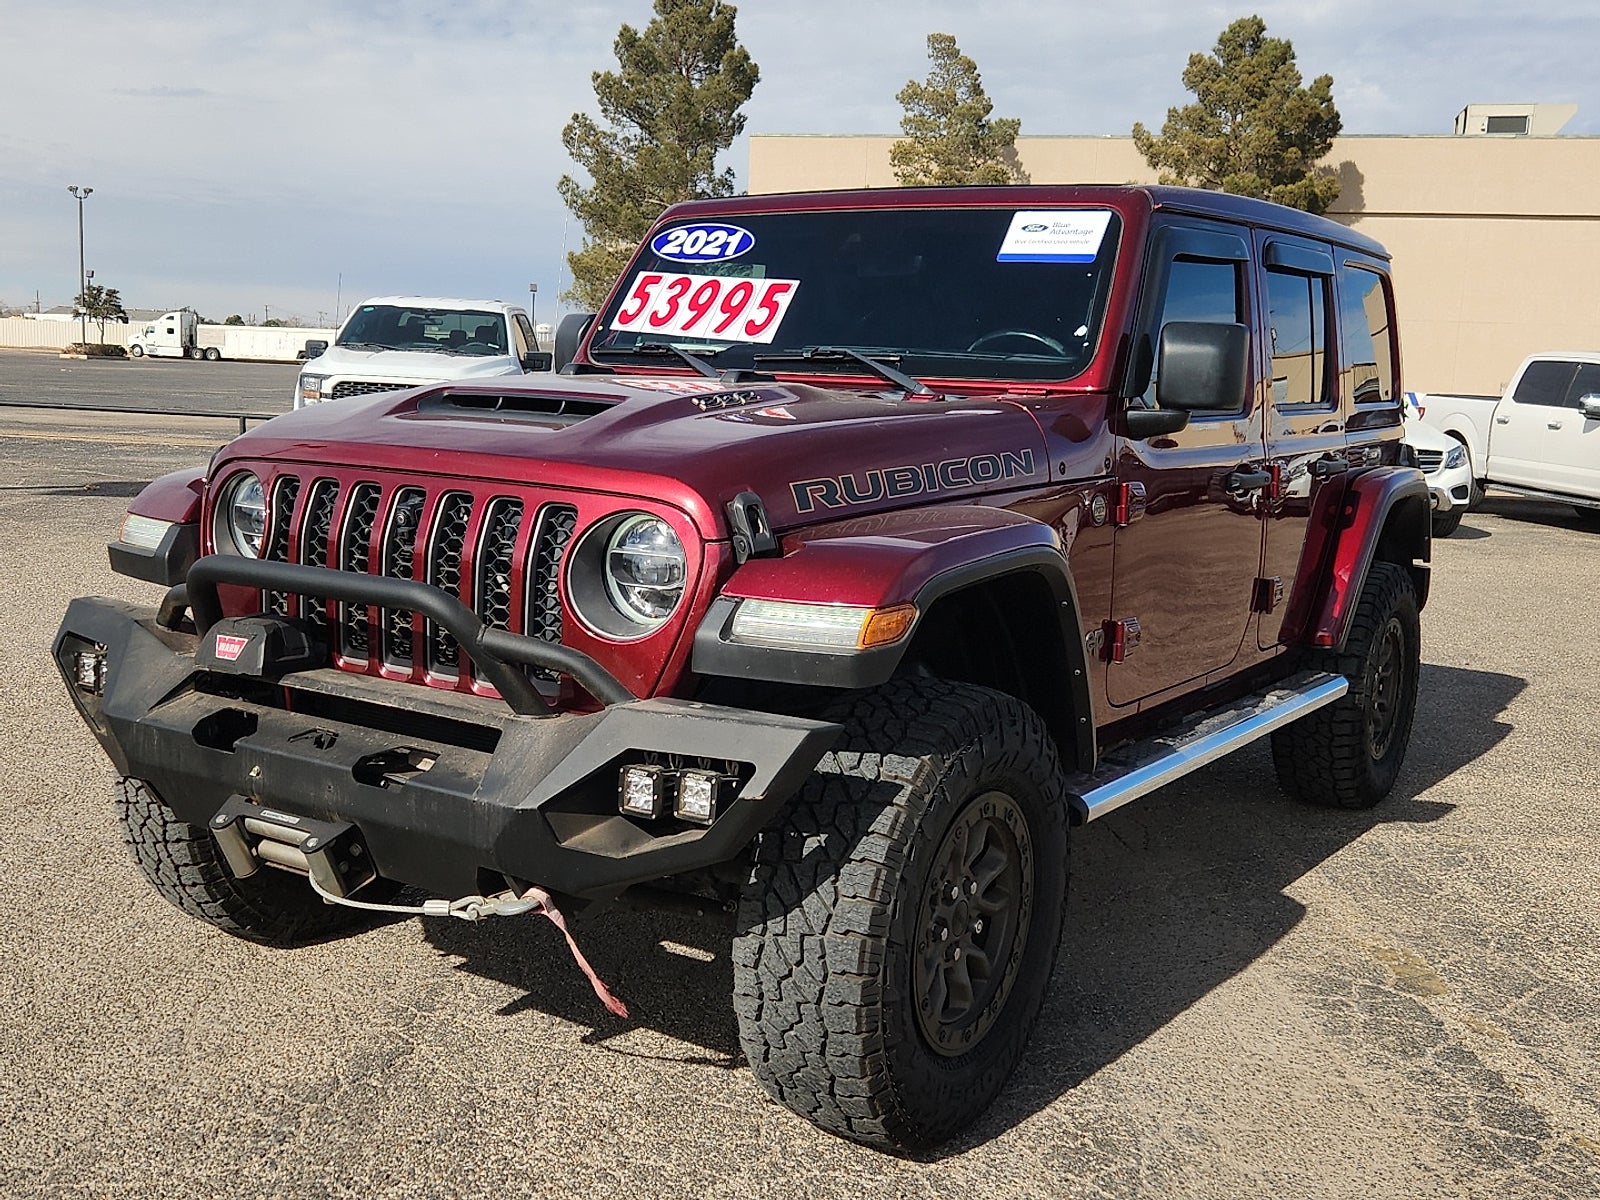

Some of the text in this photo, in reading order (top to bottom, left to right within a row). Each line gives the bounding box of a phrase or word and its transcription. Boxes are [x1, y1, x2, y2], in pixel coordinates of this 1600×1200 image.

[660, 229, 744, 256] 2021
[618, 275, 793, 337] 53995
[789, 449, 1035, 513] RUBICON
[218, 642, 240, 654] WARN
